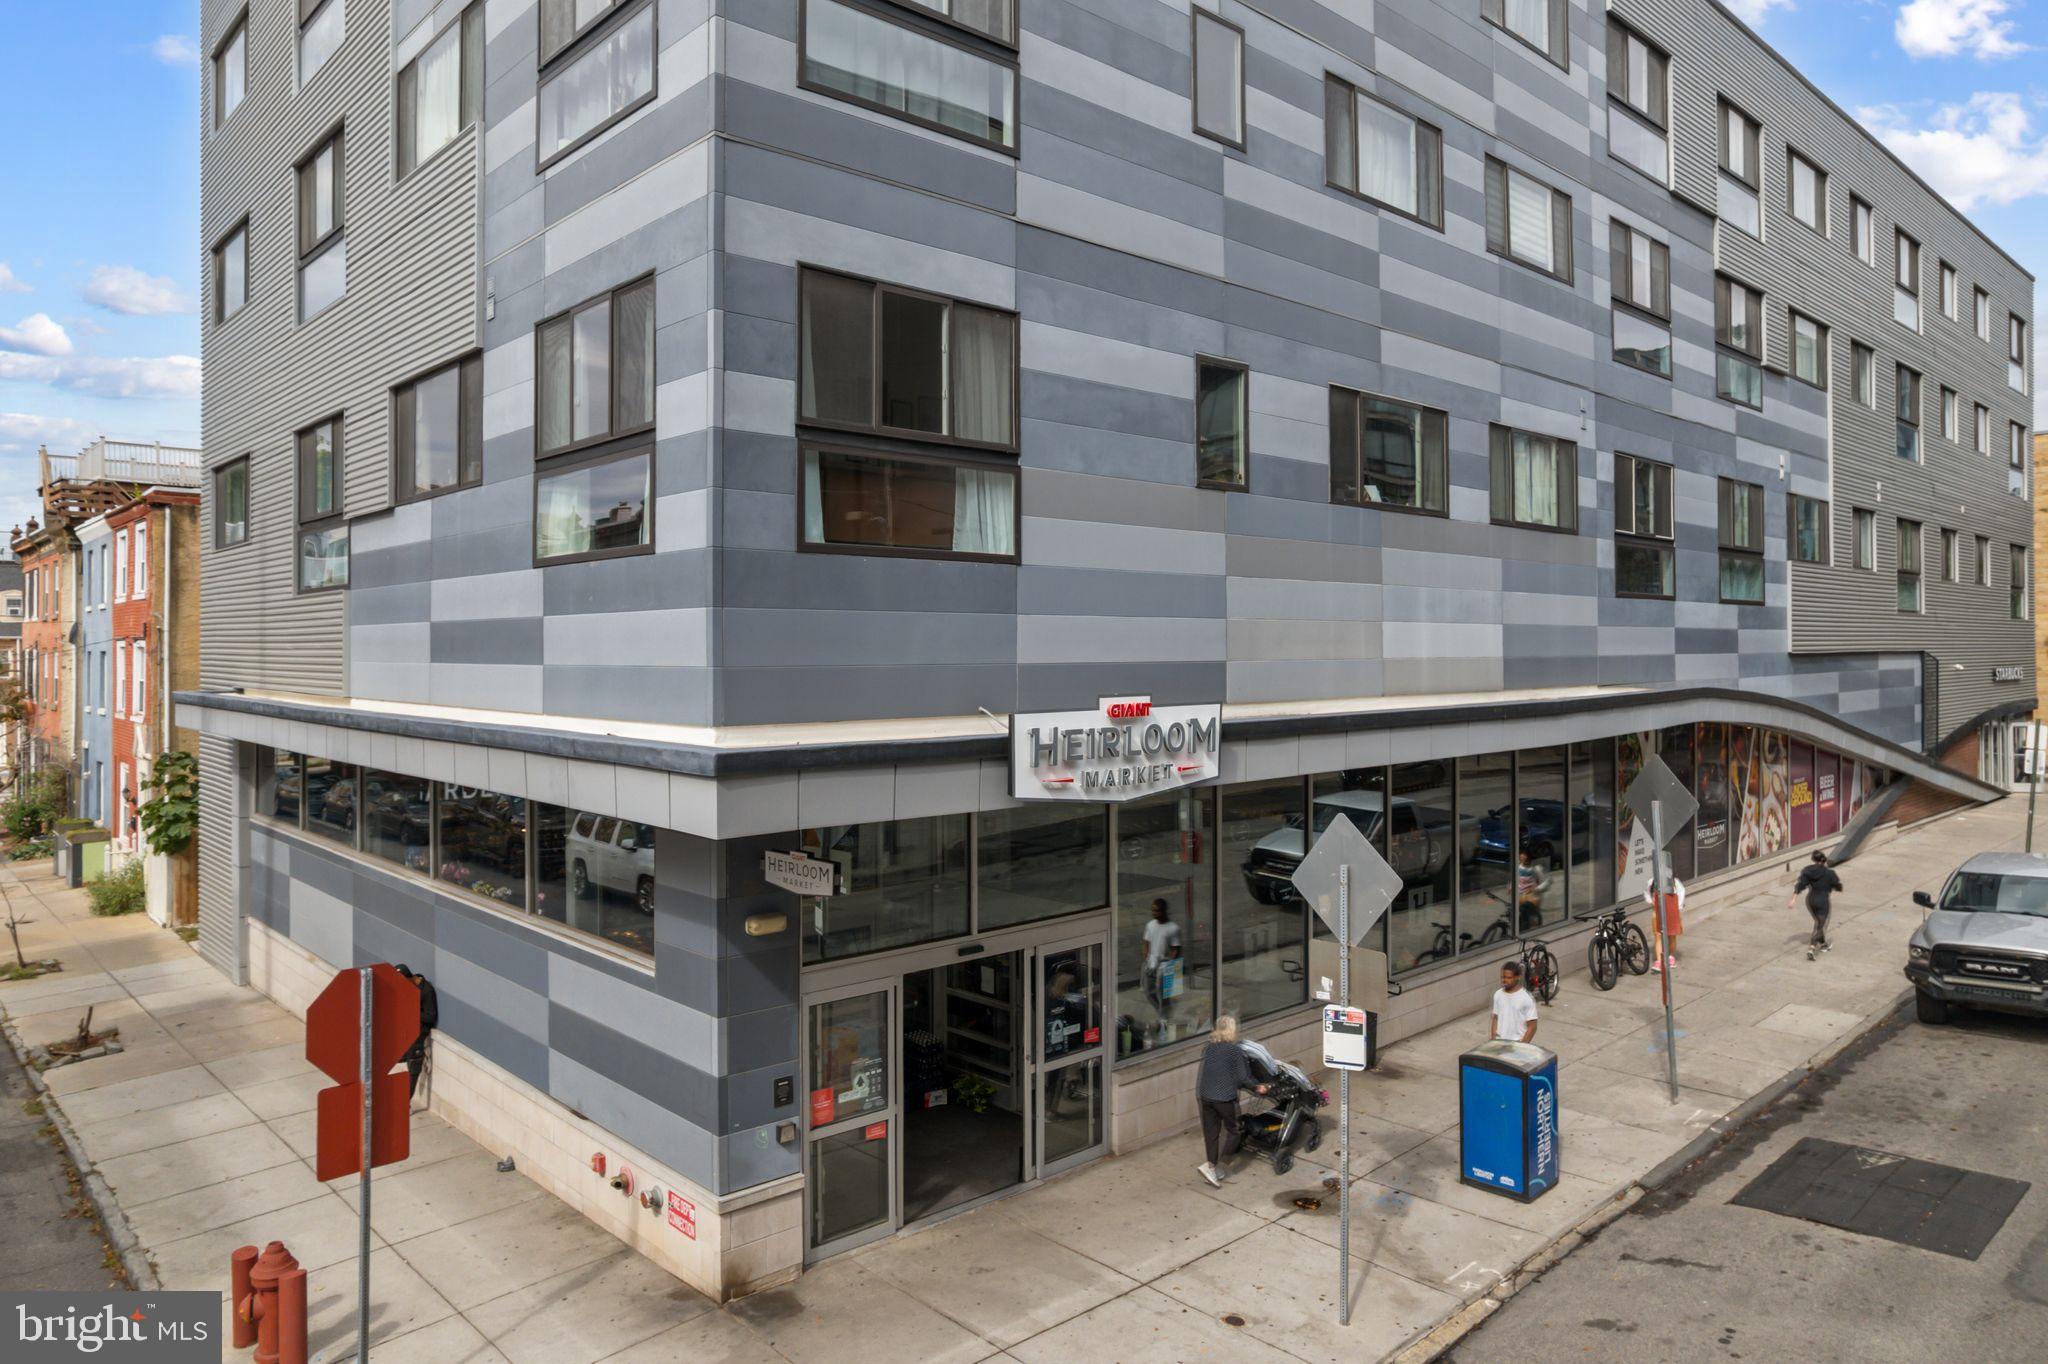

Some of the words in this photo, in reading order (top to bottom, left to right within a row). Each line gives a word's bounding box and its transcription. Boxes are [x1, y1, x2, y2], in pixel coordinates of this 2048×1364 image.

[1995, 666, 2024, 681] STARBUCKS
[1107, 702, 1152, 719] GIANT
[1028, 717, 1216, 768] HEIRLOOM
[1081, 763, 1174, 788] MARKET
[1819, 774, 1835, 790] BEER
[1791, 790, 1812, 807] GROUND
[1822, 787, 1835, 800] WINE
[1697, 823, 1725, 841] HEIRLOOM
[768, 856, 830, 884] HEIRLOOM
[783, 876, 814, 889] MARKET
[1966, 963, 2019, 974] RAM
[1325, 1021, 1333, 1032] 5
[1536, 1088, 1546, 1176] NORTHERN
[1543, 1091, 1552, 1164] LIBERTIES
